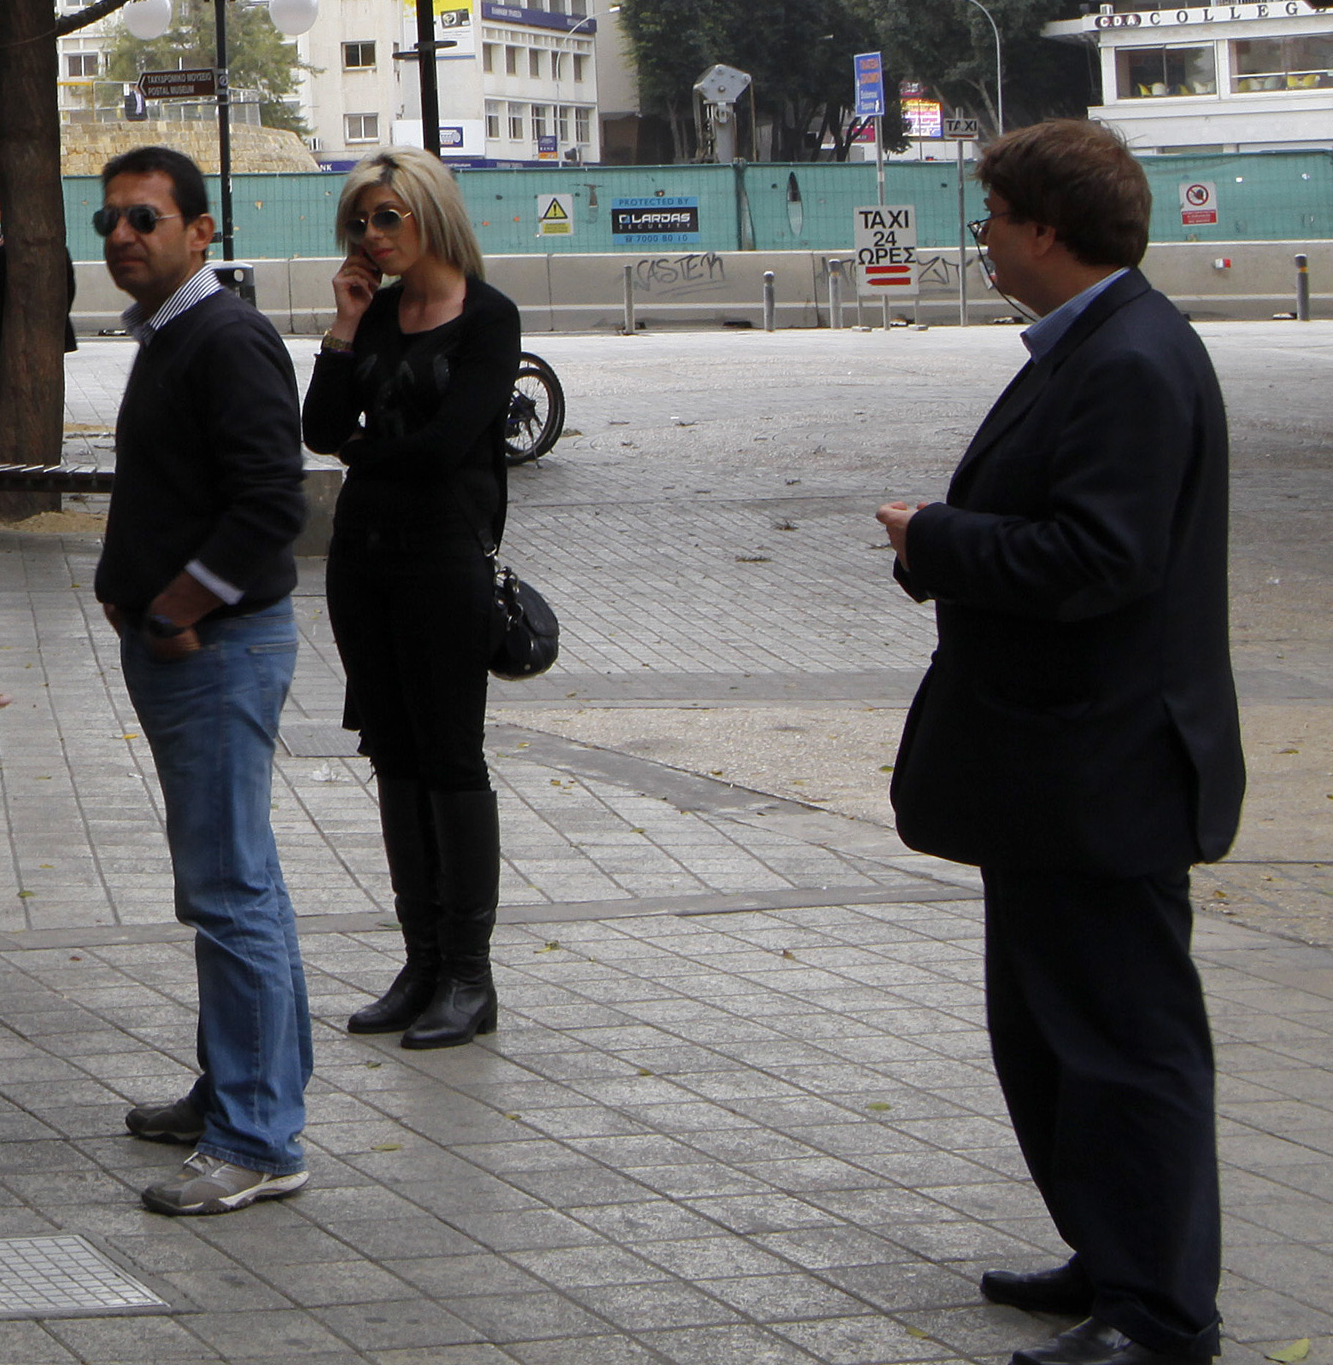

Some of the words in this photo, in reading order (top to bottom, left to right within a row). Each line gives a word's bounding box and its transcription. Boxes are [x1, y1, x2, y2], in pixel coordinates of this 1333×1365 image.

[1149, 1, 1328, 26] COLLEG
[946, 120, 977, 132] TAXI
[618, 198, 674, 207] PROTECTED
[677, 197, 689, 205] BY
[859, 210, 910, 230] TAXI
[636, 234, 659, 243] 7000
[873, 231, 897, 247] 24
[858, 246, 917, 266] ΩΡΕΣ
